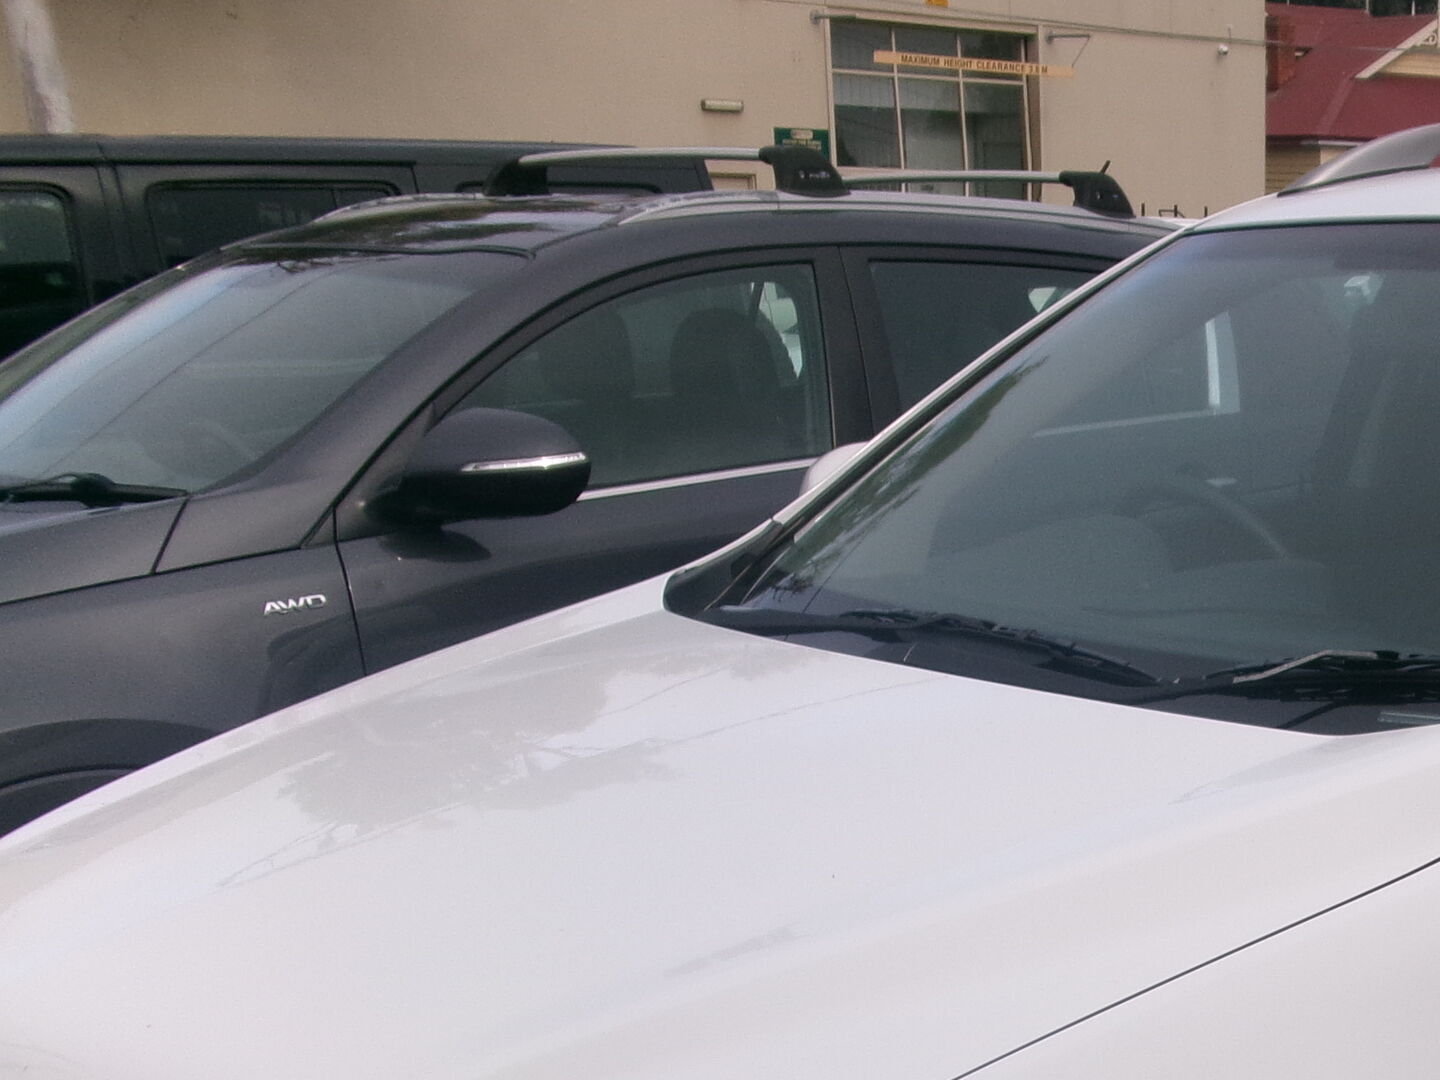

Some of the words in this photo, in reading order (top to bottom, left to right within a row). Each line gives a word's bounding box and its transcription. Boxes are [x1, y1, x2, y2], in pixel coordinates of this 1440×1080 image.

[901, 54, 940, 66] MAXIMUM
[944, 57, 973, 69] HEIGHT
[976, 60, 1025, 73] CLEARANCE
[264, 594, 327, 615] AWD
